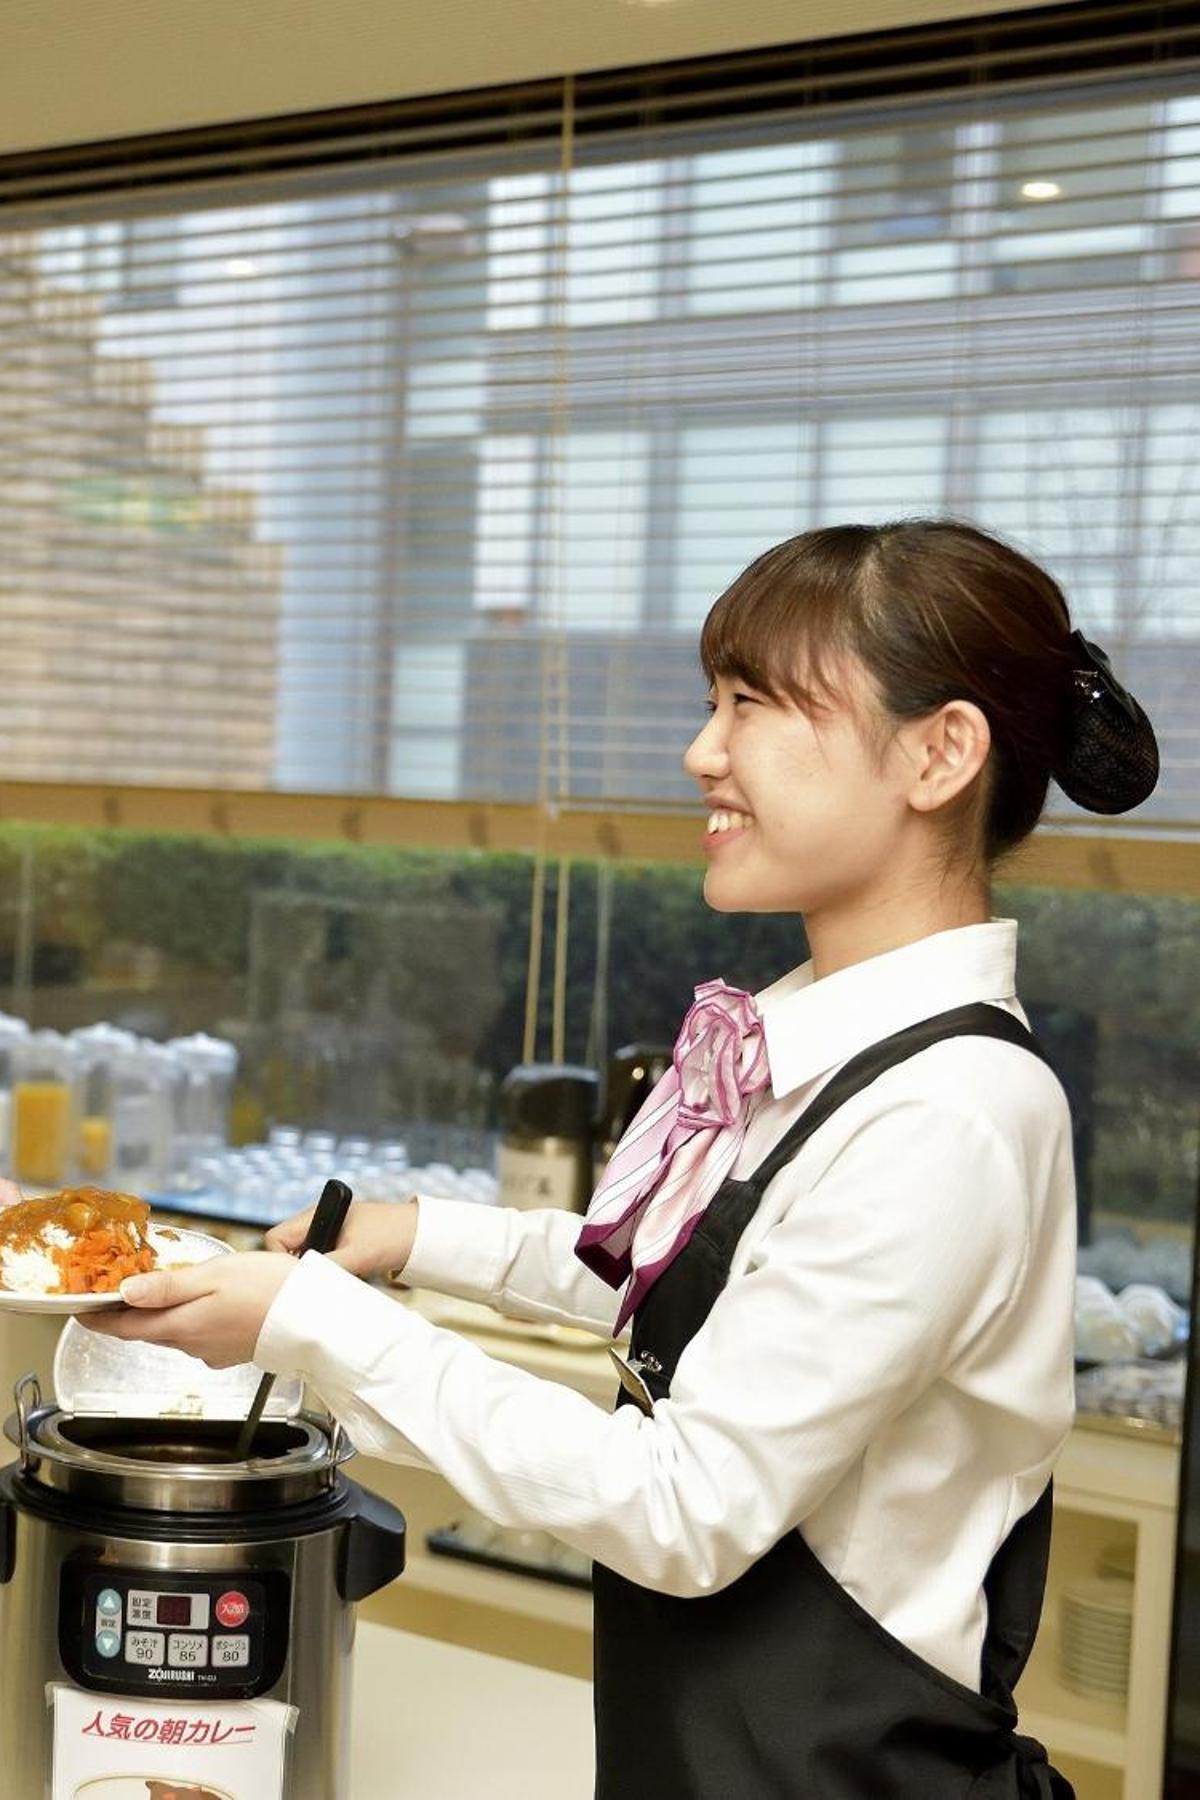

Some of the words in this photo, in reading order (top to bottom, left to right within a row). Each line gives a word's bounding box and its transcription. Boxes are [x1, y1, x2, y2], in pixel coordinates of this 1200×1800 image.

[172, 1639, 204, 1650] コンソメ
[136, 1648, 154, 1660] 90
[222, 1651, 240, 1662] 80
[81, 1710, 257, 1745] 人気の朝カレー
